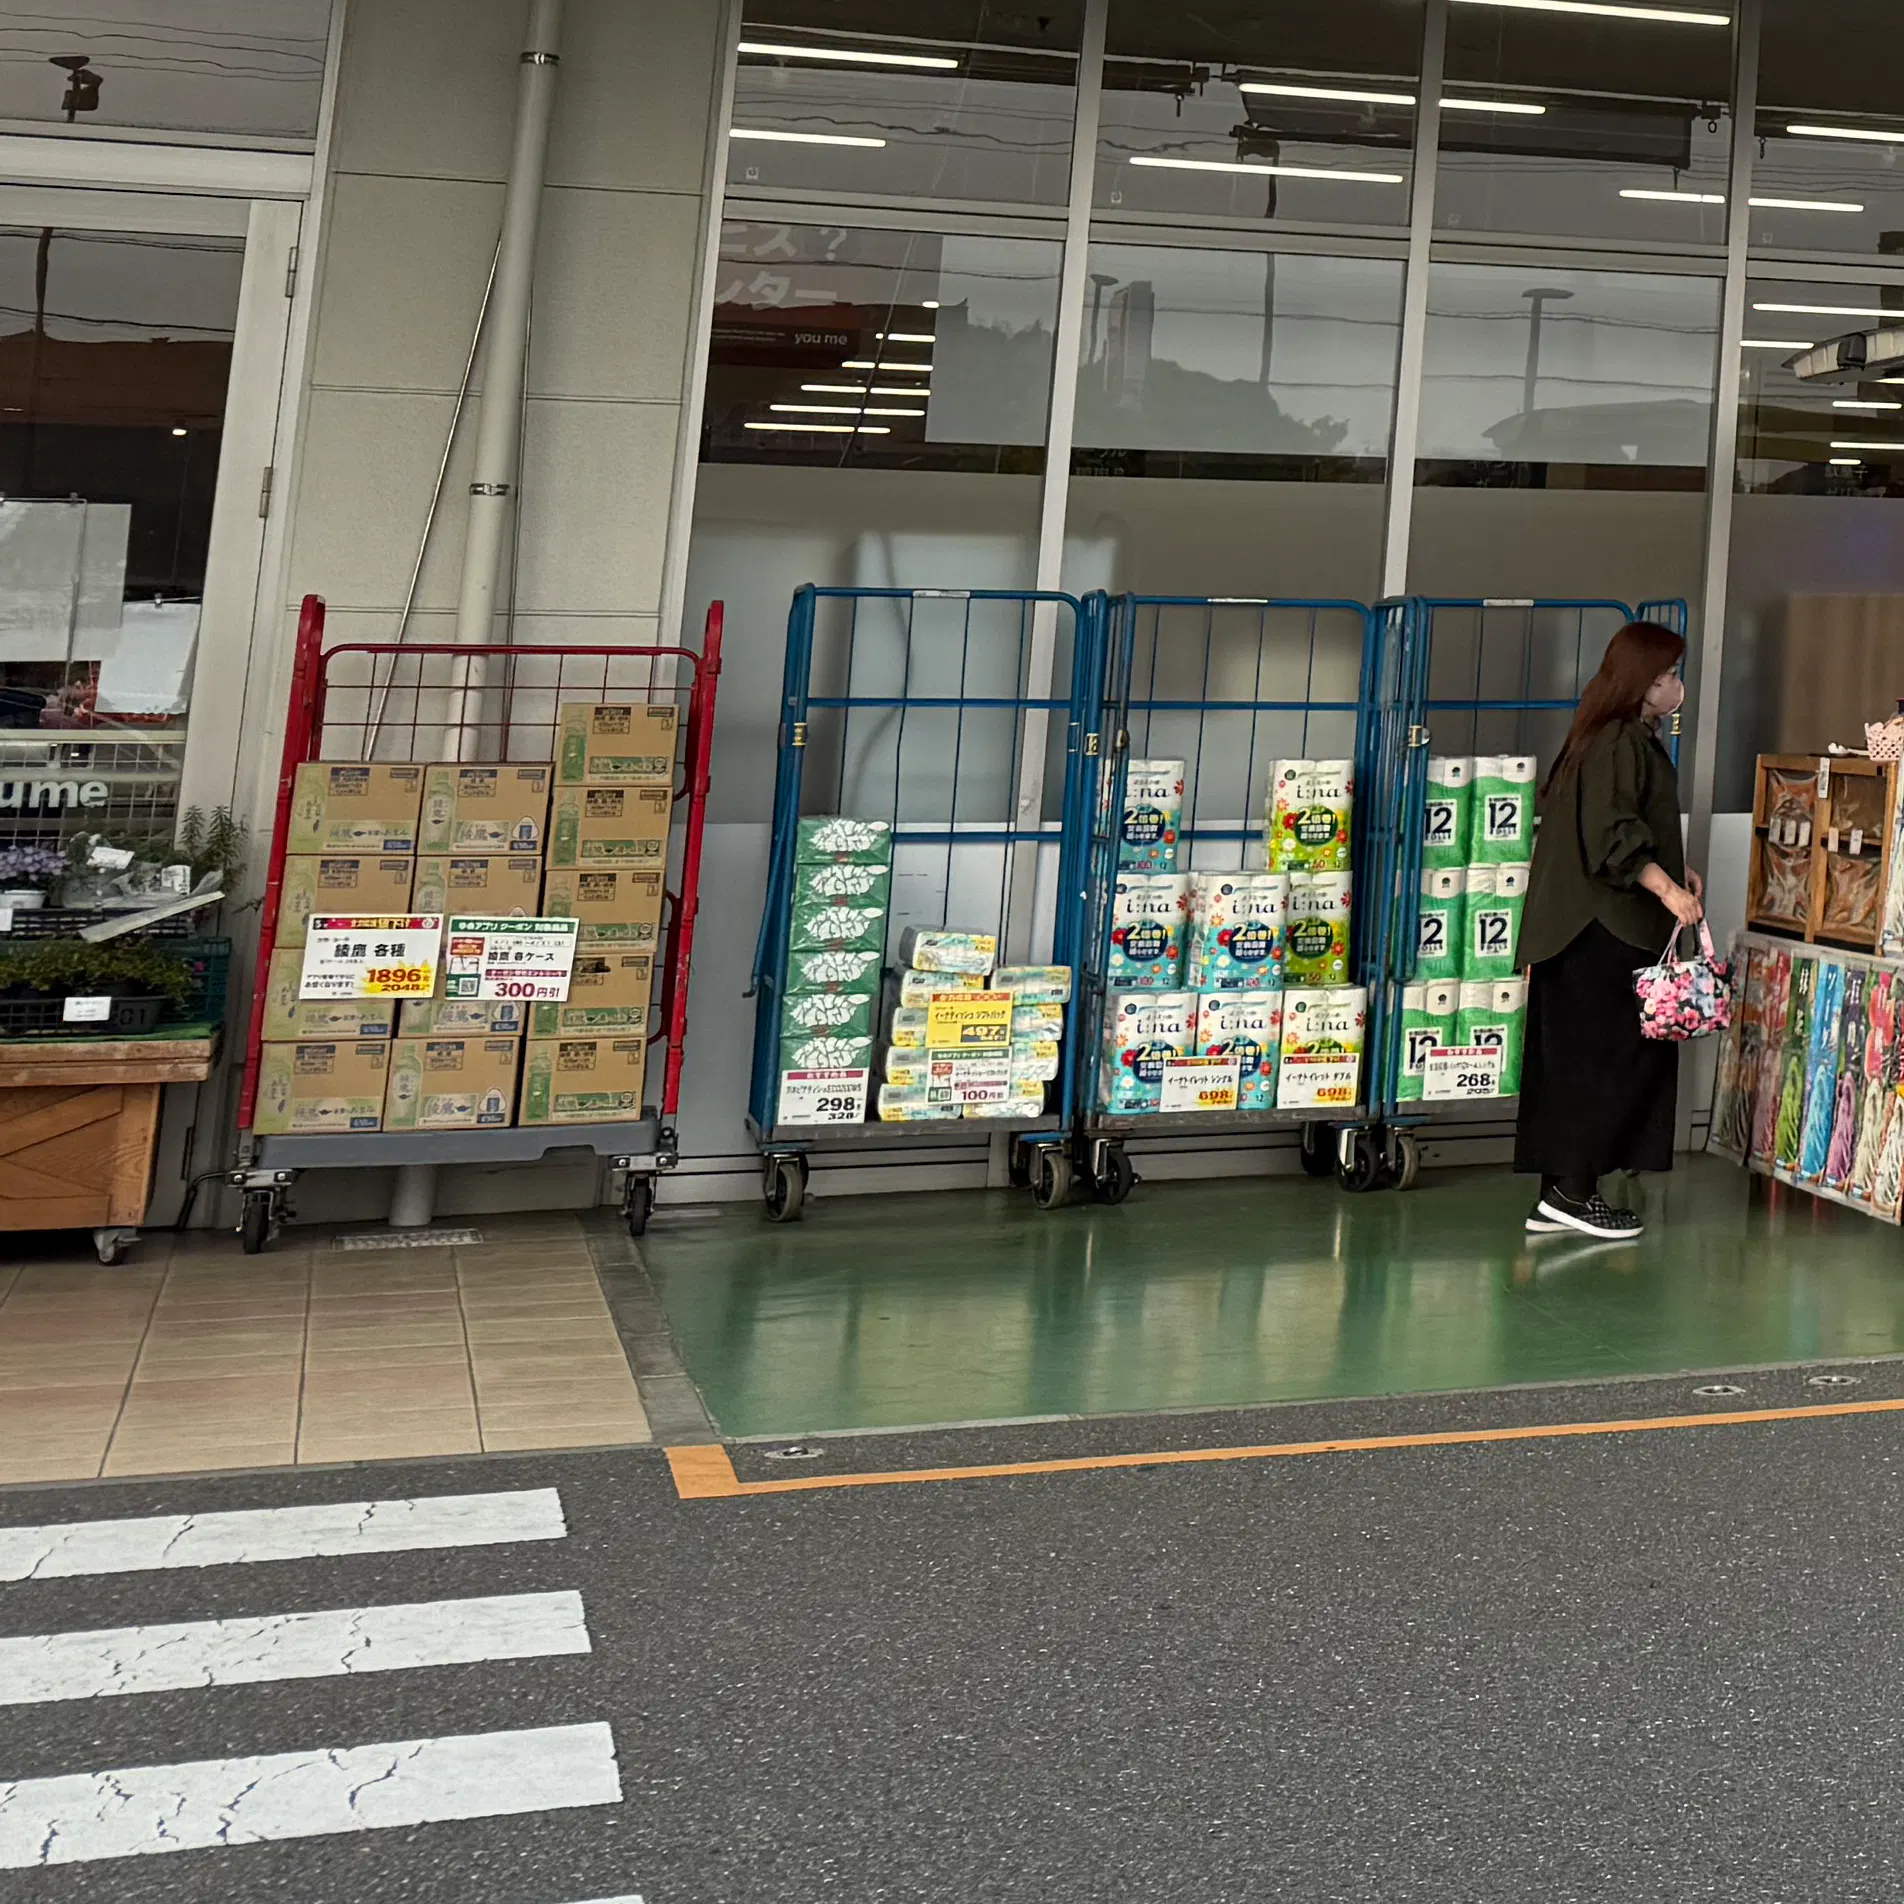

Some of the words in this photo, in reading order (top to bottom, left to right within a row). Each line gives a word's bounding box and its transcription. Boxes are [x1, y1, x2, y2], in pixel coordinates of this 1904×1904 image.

[1424, 807, 1452, 834] 12
[1489, 802, 1517, 828] 12
[1423, 918, 1443, 945] 2
[1480, 917, 1507, 944] 12
[367, 968, 422, 983] 1896
[1456, 1073, 1490, 1087] 268
[816, 1096, 855, 1112] 298
